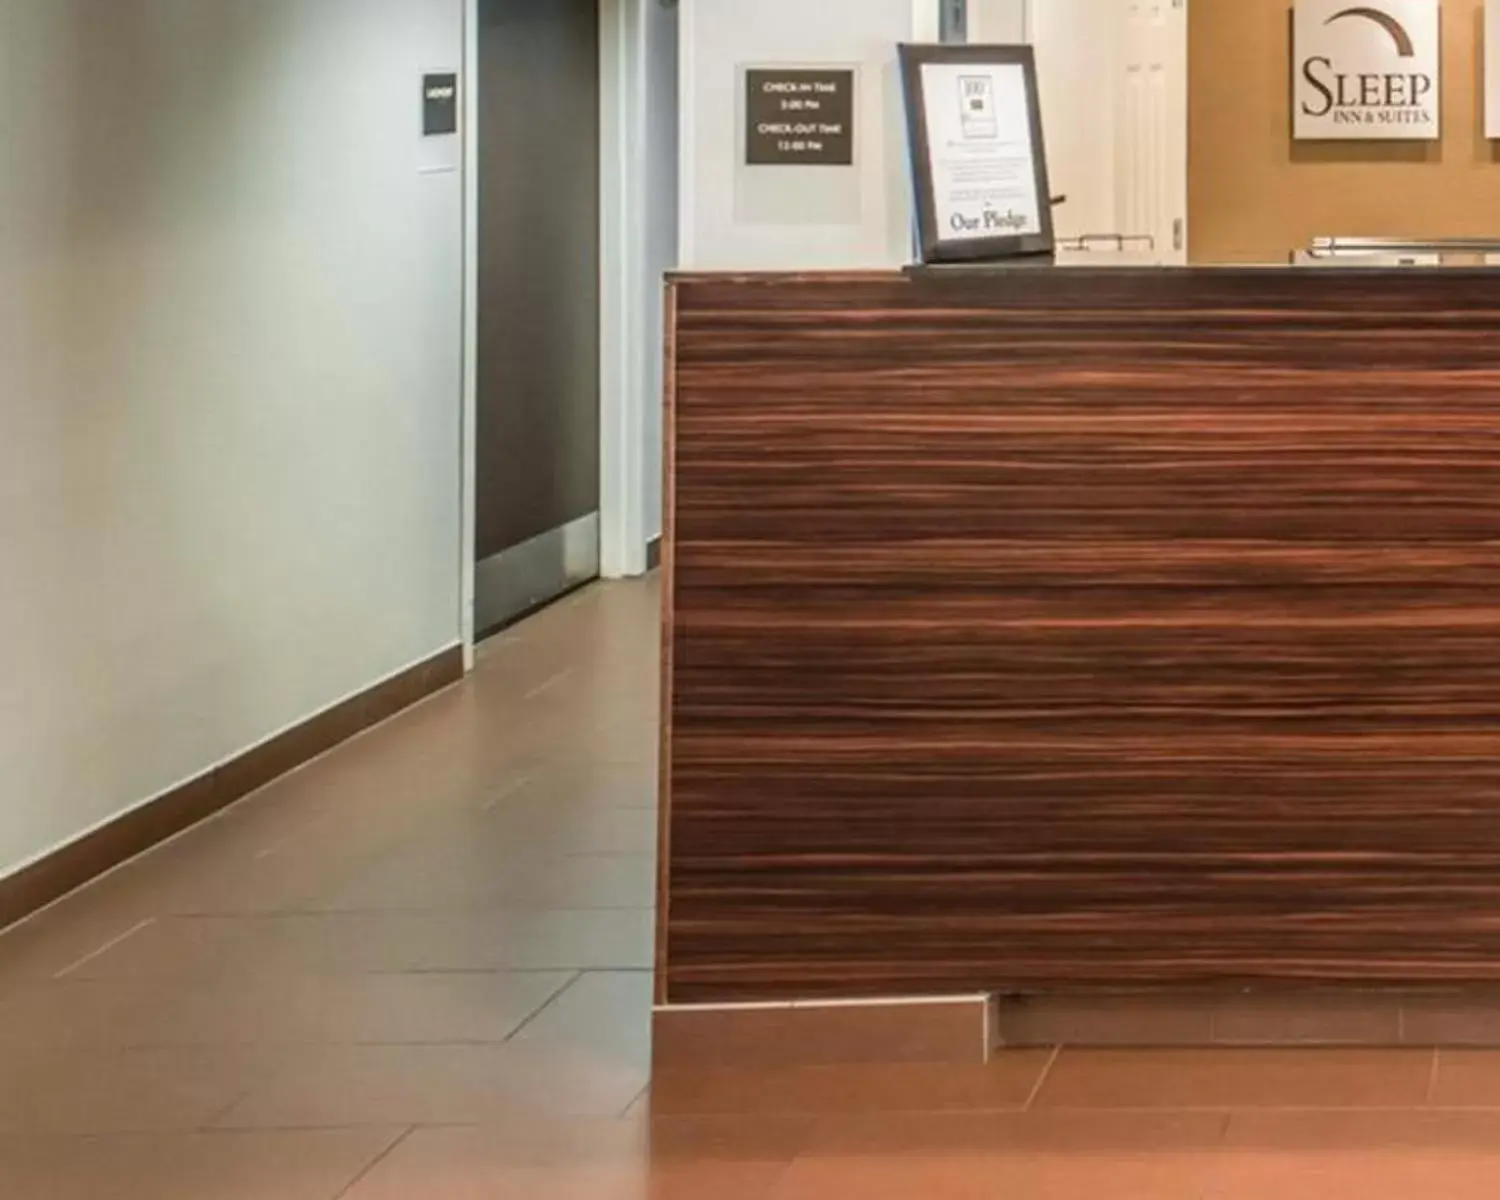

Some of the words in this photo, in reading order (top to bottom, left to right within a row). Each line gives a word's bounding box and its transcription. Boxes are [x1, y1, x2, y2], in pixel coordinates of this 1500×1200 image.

[762, 81, 813, 93] CHECK-IN
[814, 81, 837, 93] TIME
[1301, 56, 1431, 118] SLEEP
[1333, 109, 1361, 124] INN
[1363, 109, 1375, 124] &
[1377, 109, 1431, 124] SUITES
[758, 123, 817, 135] CHECK-OUT
[818, 123, 842, 134] TIME
[950, 211, 980, 231] Our
[983, 207, 1028, 230] Pledge
